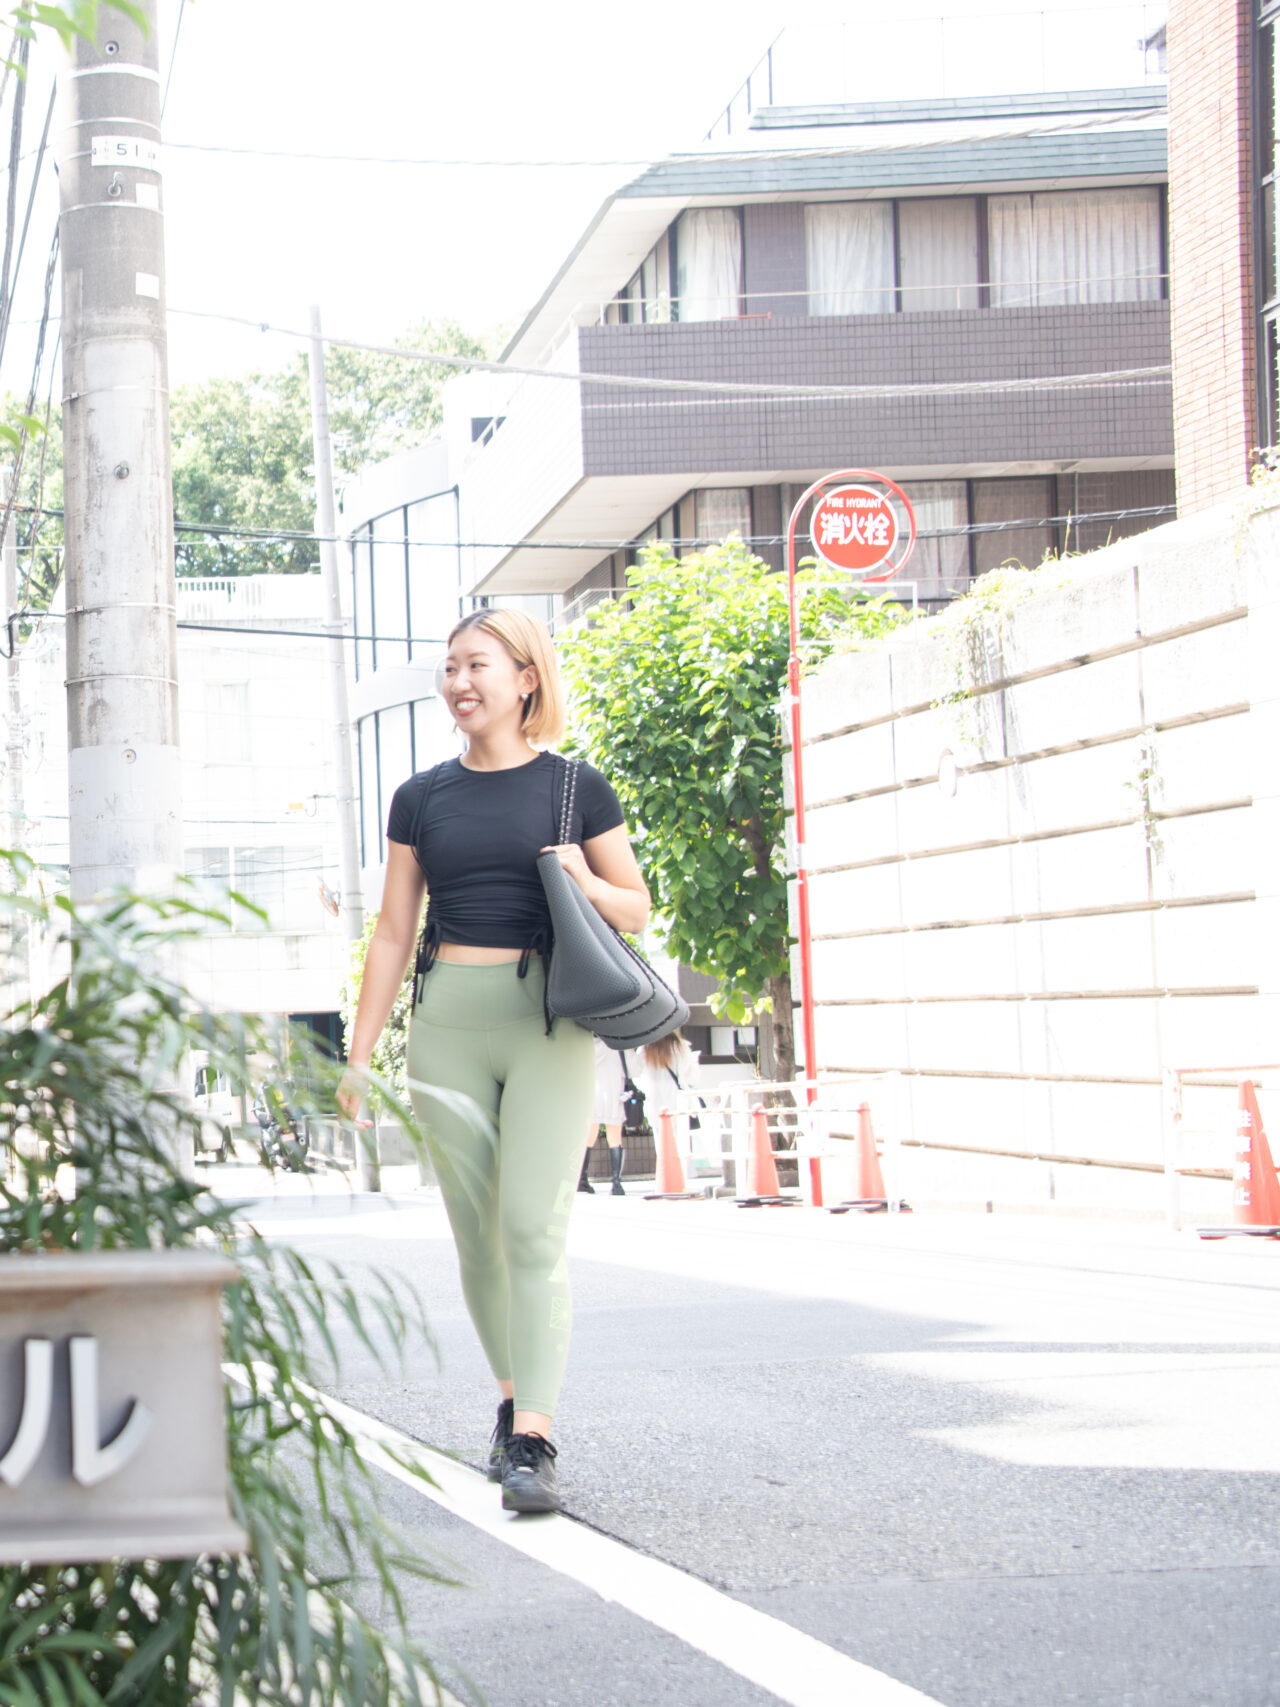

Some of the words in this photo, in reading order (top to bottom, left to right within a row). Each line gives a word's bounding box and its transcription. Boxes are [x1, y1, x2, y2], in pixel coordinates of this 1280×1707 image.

[826, 497, 844, 508] FIRE
[846, 497, 882, 508] HYDRANT
[820, 512, 890, 545] 消火栓
